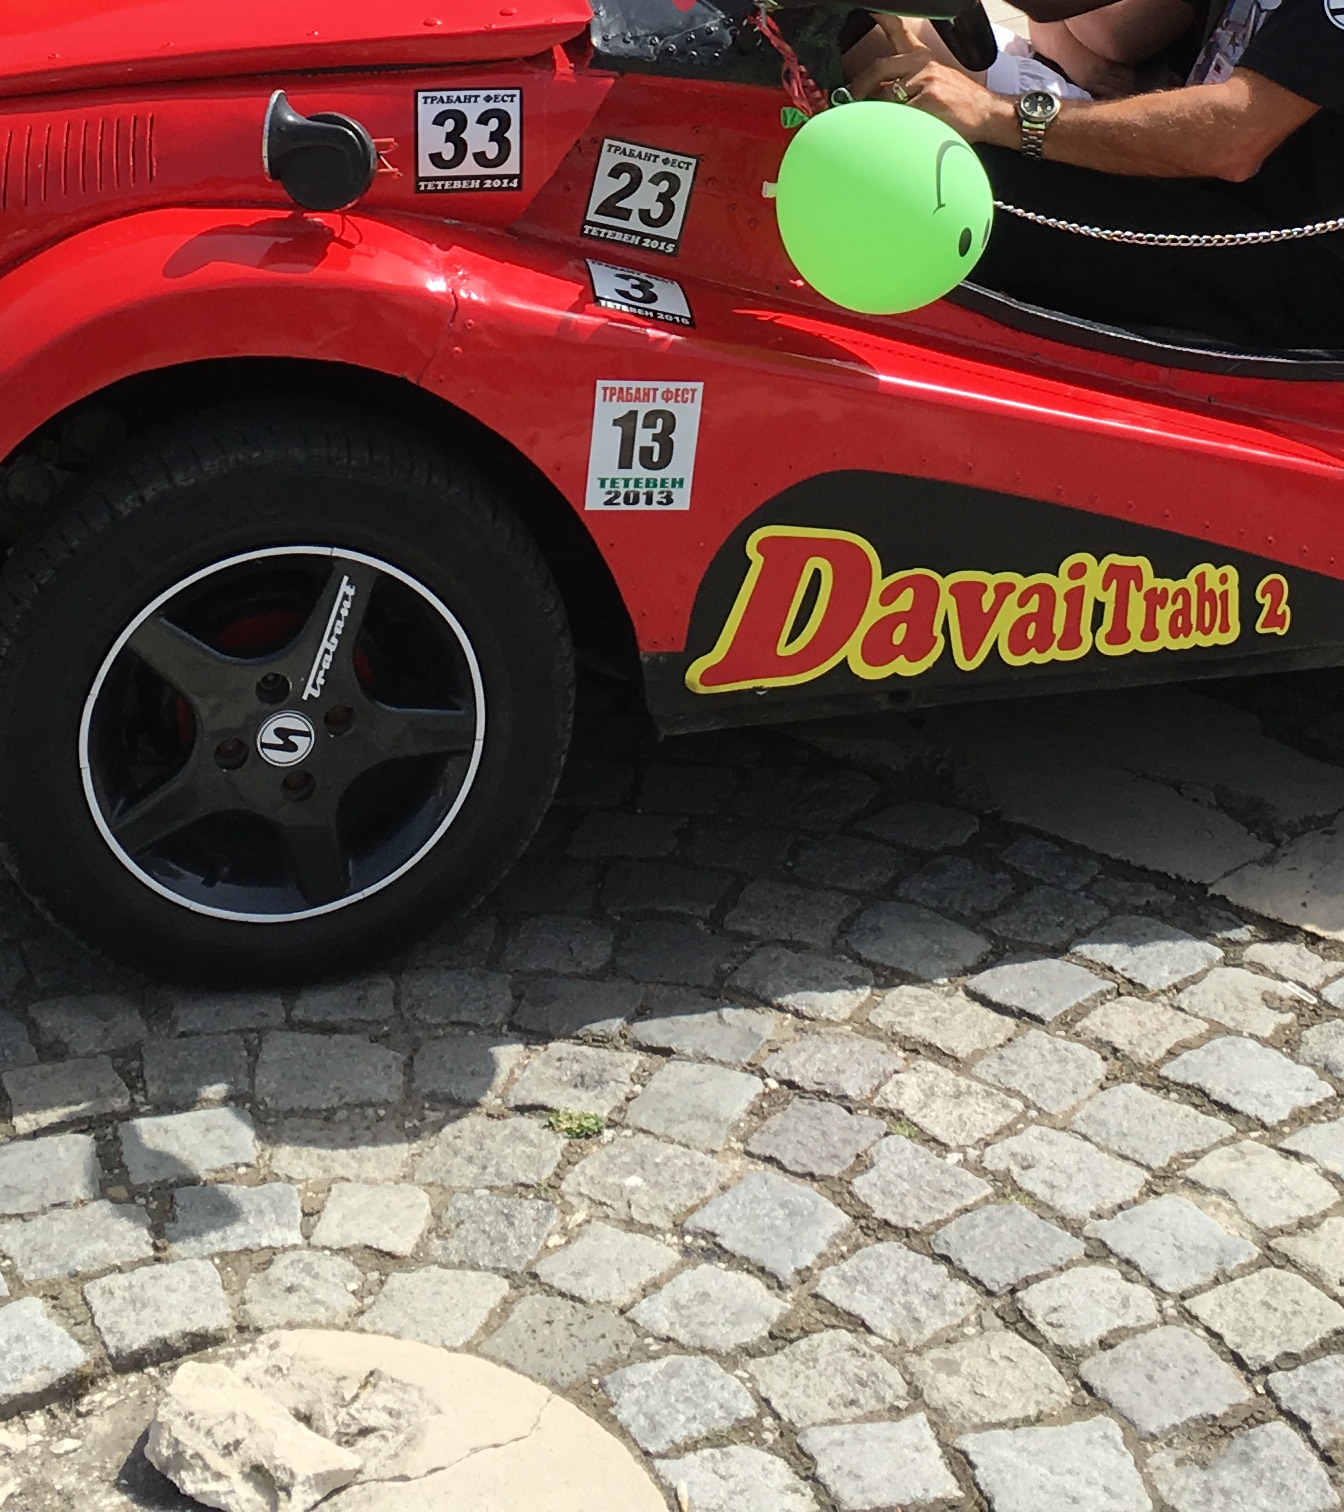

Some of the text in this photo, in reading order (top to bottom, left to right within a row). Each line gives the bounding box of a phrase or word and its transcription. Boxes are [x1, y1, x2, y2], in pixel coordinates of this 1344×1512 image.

[421, 93, 517, 105] ТРАБАНТ ФЕСТ
[427, 108, 513, 170] 33
[605, 142, 693, 172] ТРАБАНТ ФЕСТ
[418, 177, 519, 191] ТЕТЕВЕН 2014
[593, 161, 682, 229] 23
[583, 224, 676, 254] ТЕТЕВЕН 2015
[614, 273, 659, 304] 3
[598, 299, 690, 325] ТЕТЕВЕН 2016
[601, 386, 697, 404] ТРАБАНТ ФЕСТ
[612, 408, 677, 471] 13
[597, 477, 685, 490] ТЕТЕВЕН
[602, 490, 675, 506] 2013
[1255, 574, 1291, 636] 2
